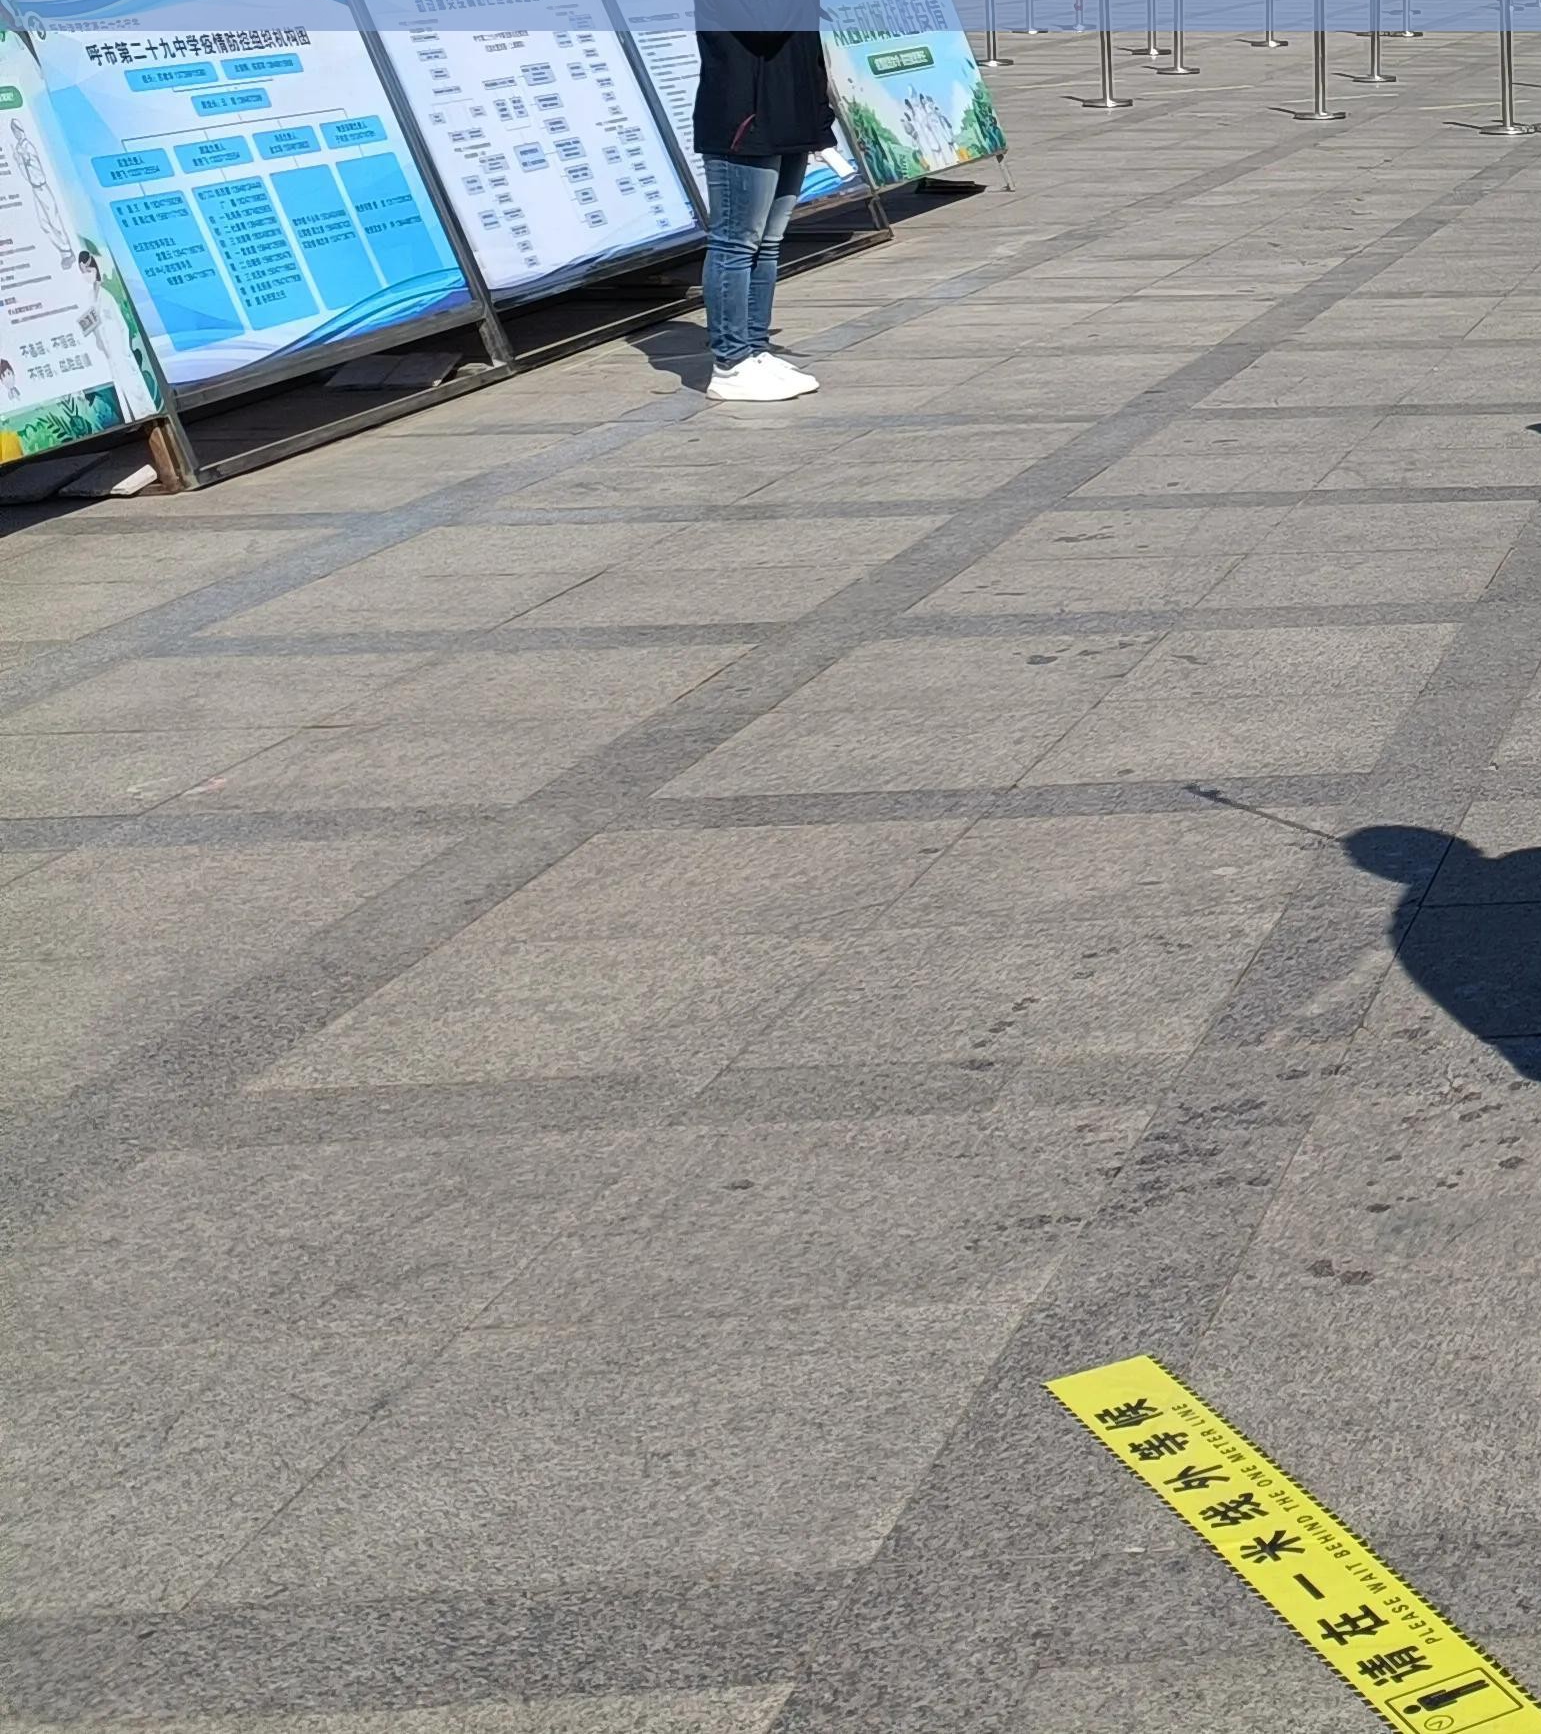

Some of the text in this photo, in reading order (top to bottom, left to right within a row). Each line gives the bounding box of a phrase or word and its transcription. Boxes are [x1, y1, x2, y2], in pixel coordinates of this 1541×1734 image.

[85, 25, 311, 67] 呼市第二十九中学疫情防控组织机构图
[1093, 1397, 1434, 1689] 请在一米线外等候
[1171, 1403, 1443, 1645] PLEASE WAIT BEHIND THE ONE METER LINE
